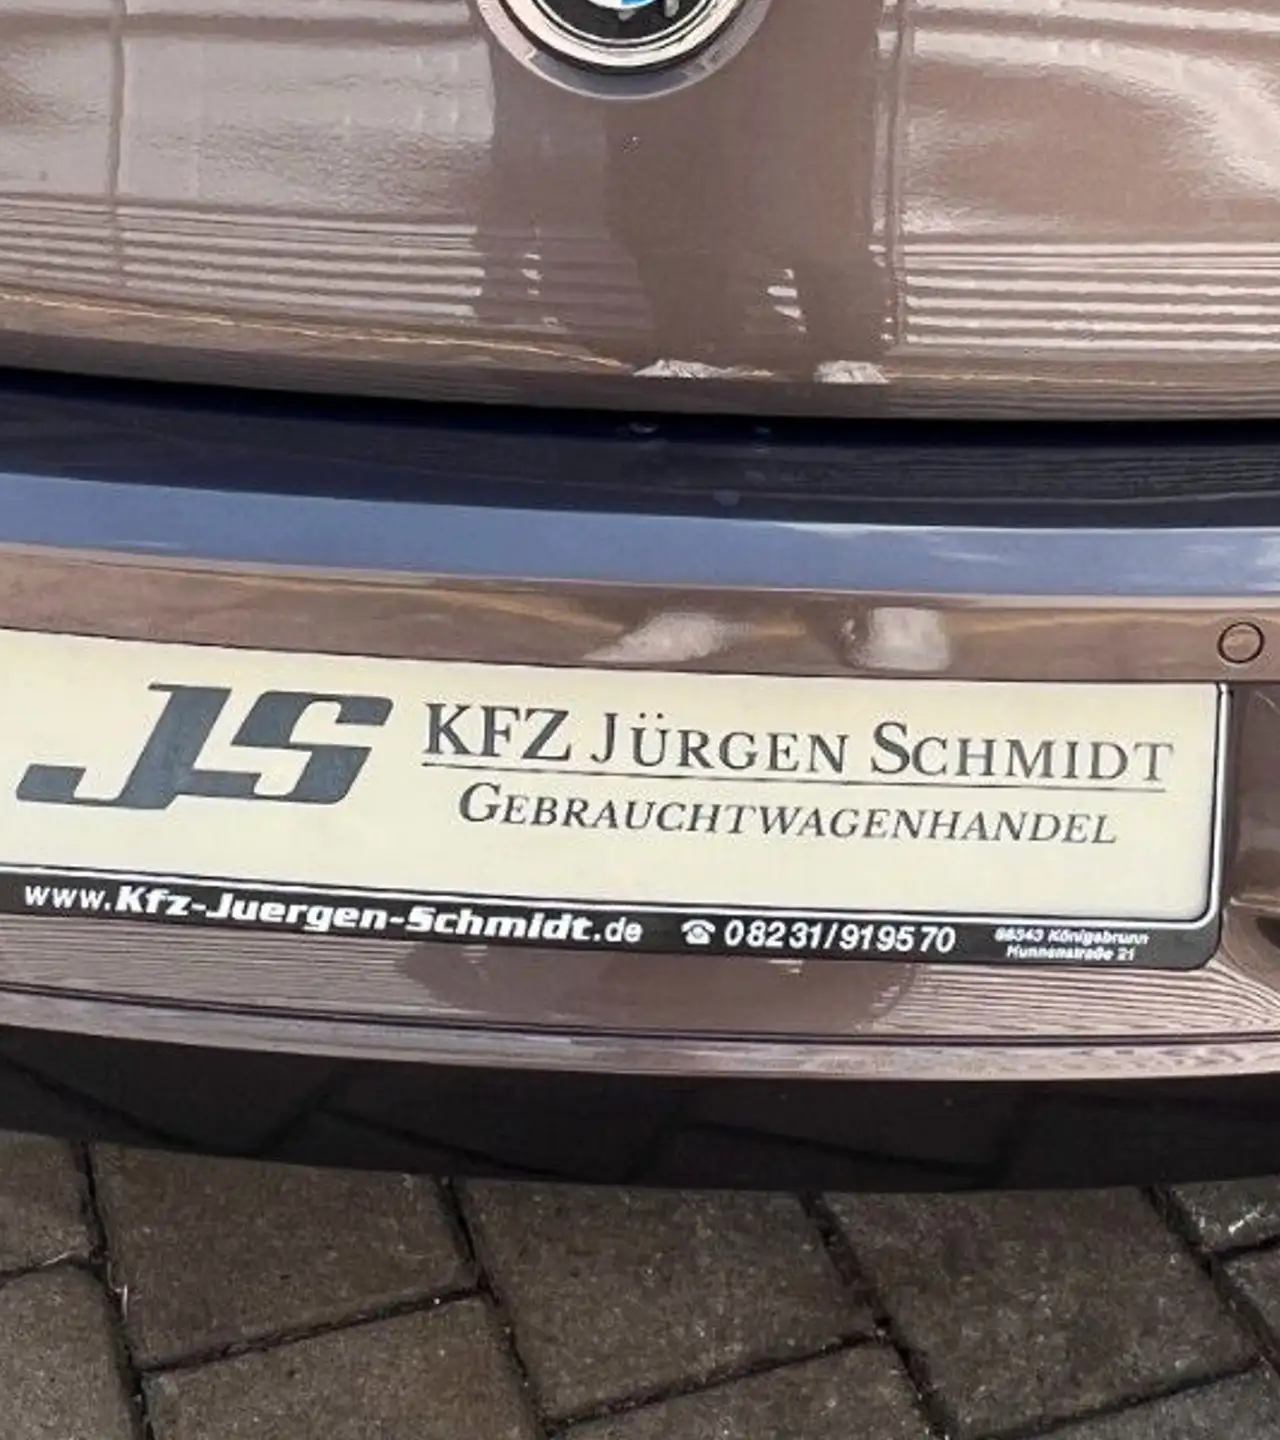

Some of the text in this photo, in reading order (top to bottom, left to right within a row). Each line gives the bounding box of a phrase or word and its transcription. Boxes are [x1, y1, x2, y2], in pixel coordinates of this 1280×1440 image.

[16, 681, 394, 811] JS
[423, 702, 1174, 783] KFZ JÜRGEN SCHMIDT
[458, 781, 1118, 846] GEBRAUCHTWAGENHANDEL
[23, 884, 957, 954] www.Kfz-Juergen-Schmidt.de 08231/919570
